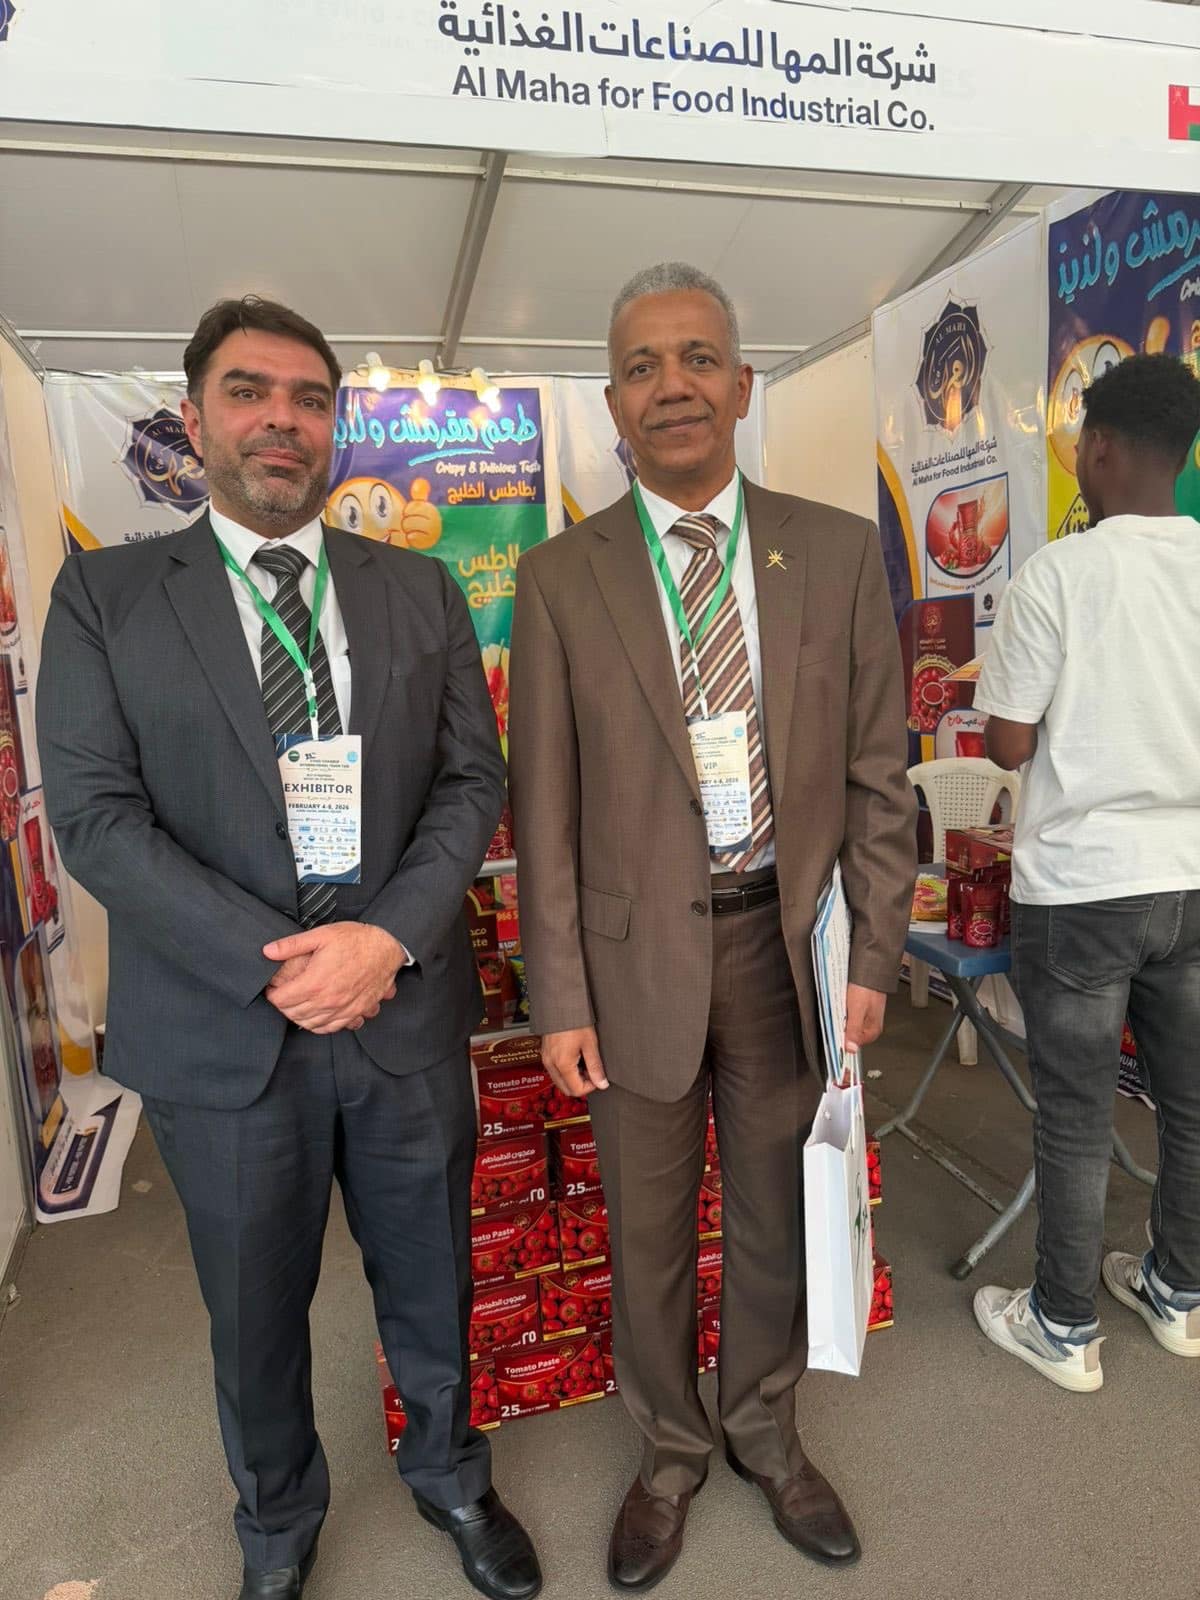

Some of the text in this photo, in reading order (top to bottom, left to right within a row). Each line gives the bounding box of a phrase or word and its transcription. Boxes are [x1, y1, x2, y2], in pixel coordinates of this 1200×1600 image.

[438, 0, 936, 90] شركة المها للصناعات الغذائية
[452, 65, 935, 131] Al Maha for Food Industrial Co.
[389, 403, 479, 449] مقرمش
[480, 401, 537, 450] طعم
[436, 460, 467, 477] Crispy
[469, 461, 477, 474] &
[480, 460, 516, 474] Delicious
[942, 466, 960, 478] Food
[960, 457, 985, 473] Industrial
[986, 455, 998, 465] Co.
[447, 480, 536, 505] بطاطس الخليج
[703, 762, 718, 770] VIP
[284, 783, 353, 794] EXHIBITOR
[487, 1079, 521, 1089] Tomato
[521, 1075, 545, 1084] Paste
[483, 1122, 503, 1137] 25
[566, 1182, 586, 1196] 25
[472, 1232, 491, 1243] mato
[492, 1228, 515, 1239] Paste
[504, 1364, 537, 1375] Tomato
[538, 1357, 560, 1368] Paste
[708, 1356, 717, 1367] 2
[501, 1404, 520, 1417] 25
